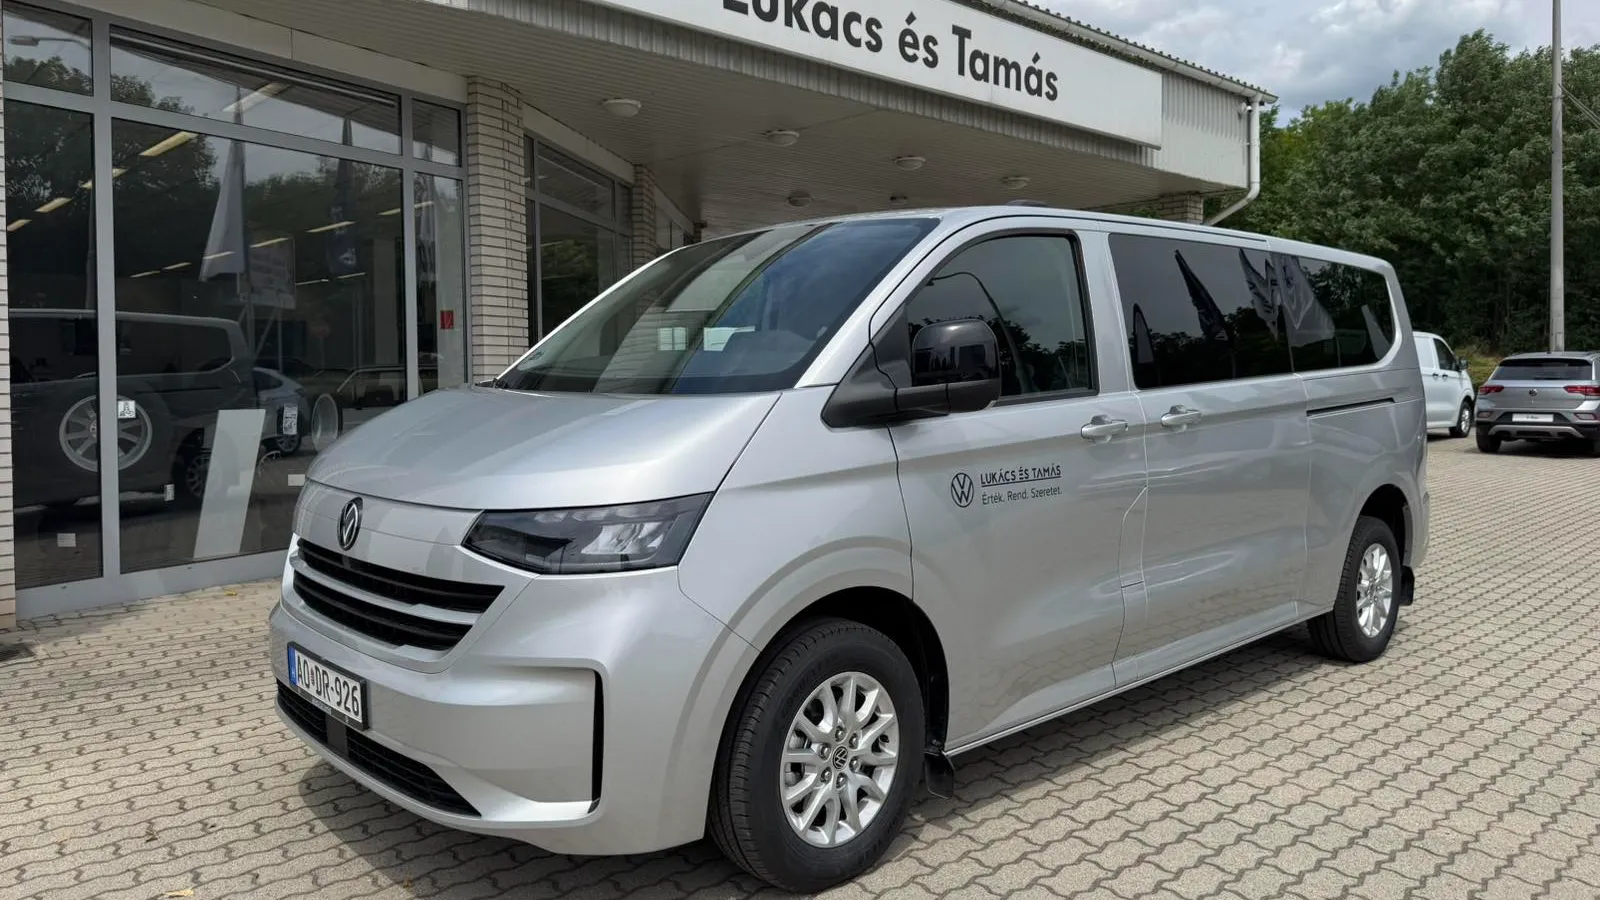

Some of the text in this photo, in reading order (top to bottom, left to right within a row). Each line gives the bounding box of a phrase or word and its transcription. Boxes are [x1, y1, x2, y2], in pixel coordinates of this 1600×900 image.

[898, 11, 939, 69] és
[952, 24, 1058, 101] Tamás
[980, 463, 1061, 485] LUKÁCS ÉS TAMÁS
[981, 485, 1062, 505] Érték. Rend. Szeretet.
